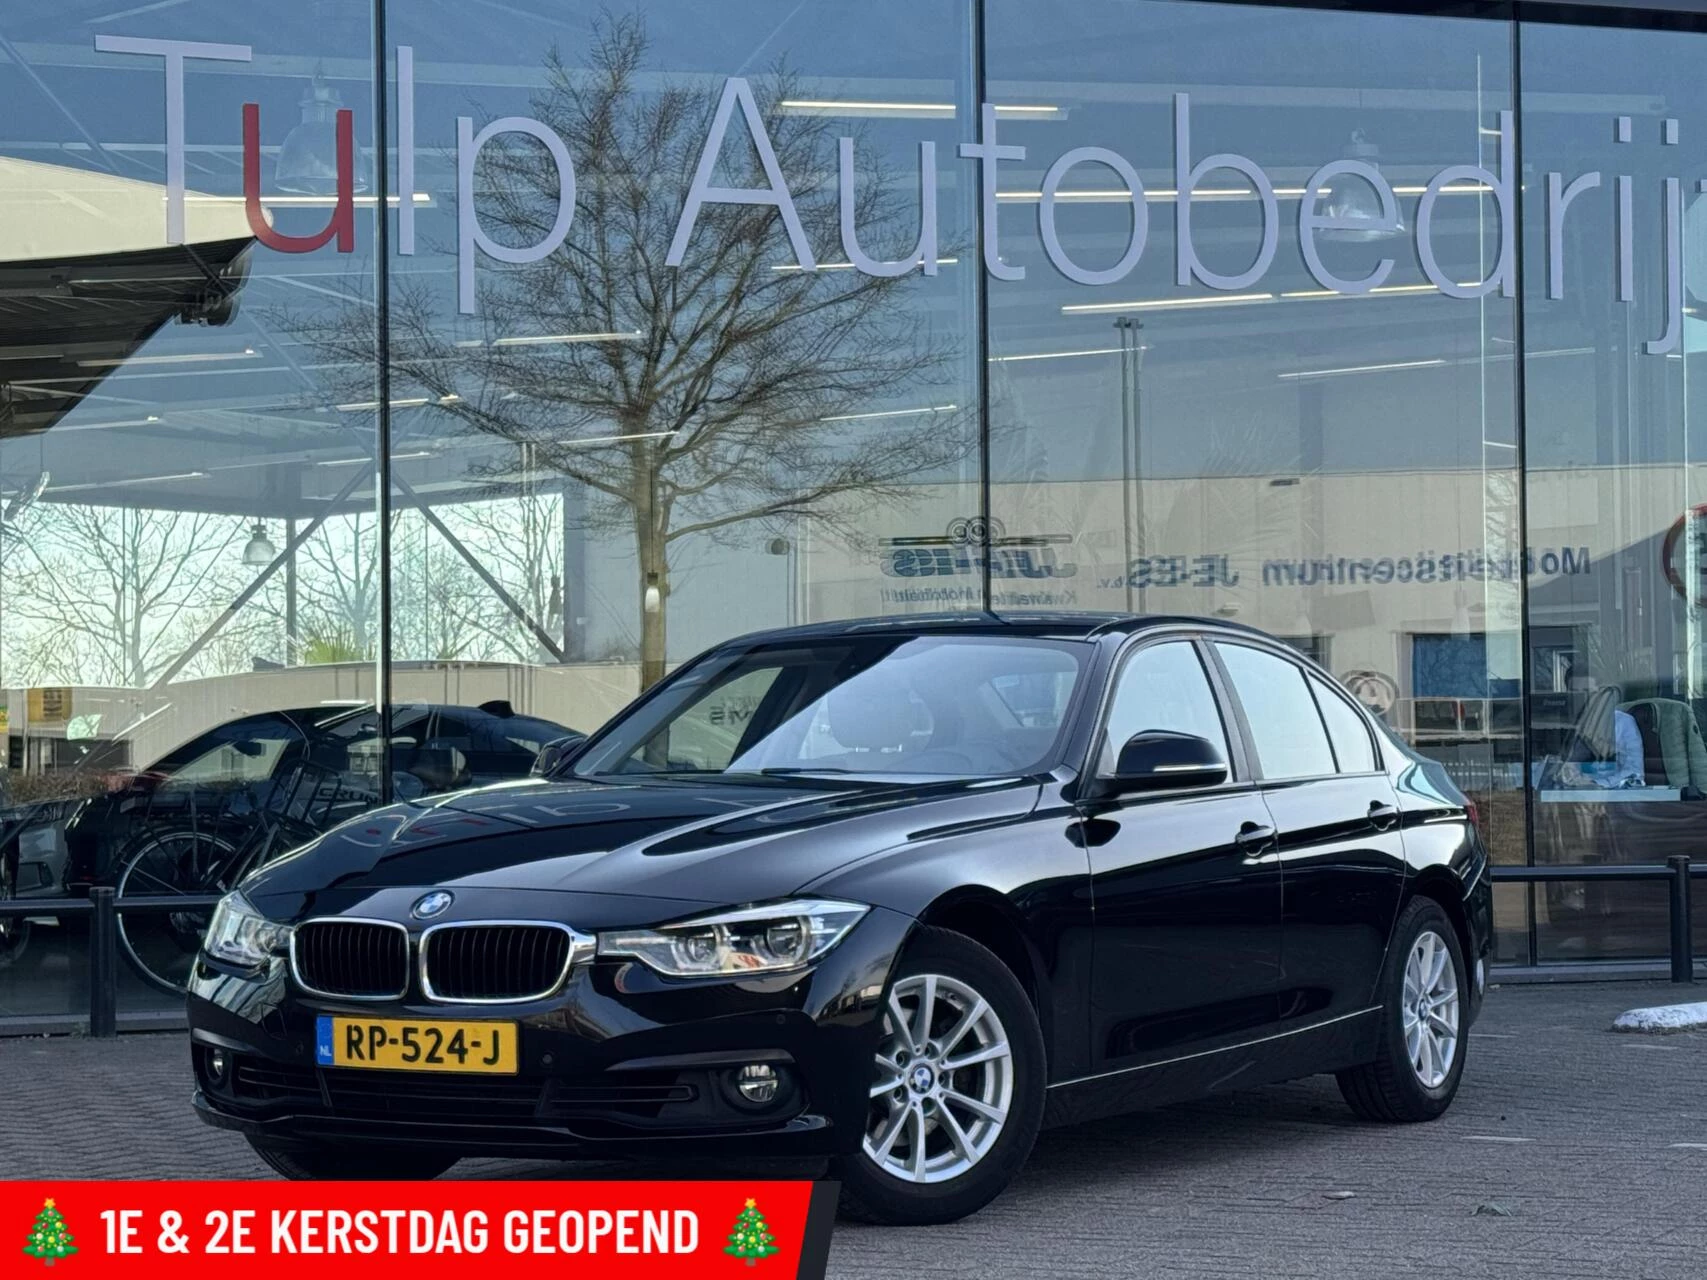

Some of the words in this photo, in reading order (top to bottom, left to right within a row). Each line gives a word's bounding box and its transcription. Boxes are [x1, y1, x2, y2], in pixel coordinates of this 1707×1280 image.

[95, 35, 578, 315] Tulp
[665, 76, 1707, 355] Autobedrij
[319, 1045, 332, 1057] NL
[346, 1024, 500, 1066] RP-524-J
